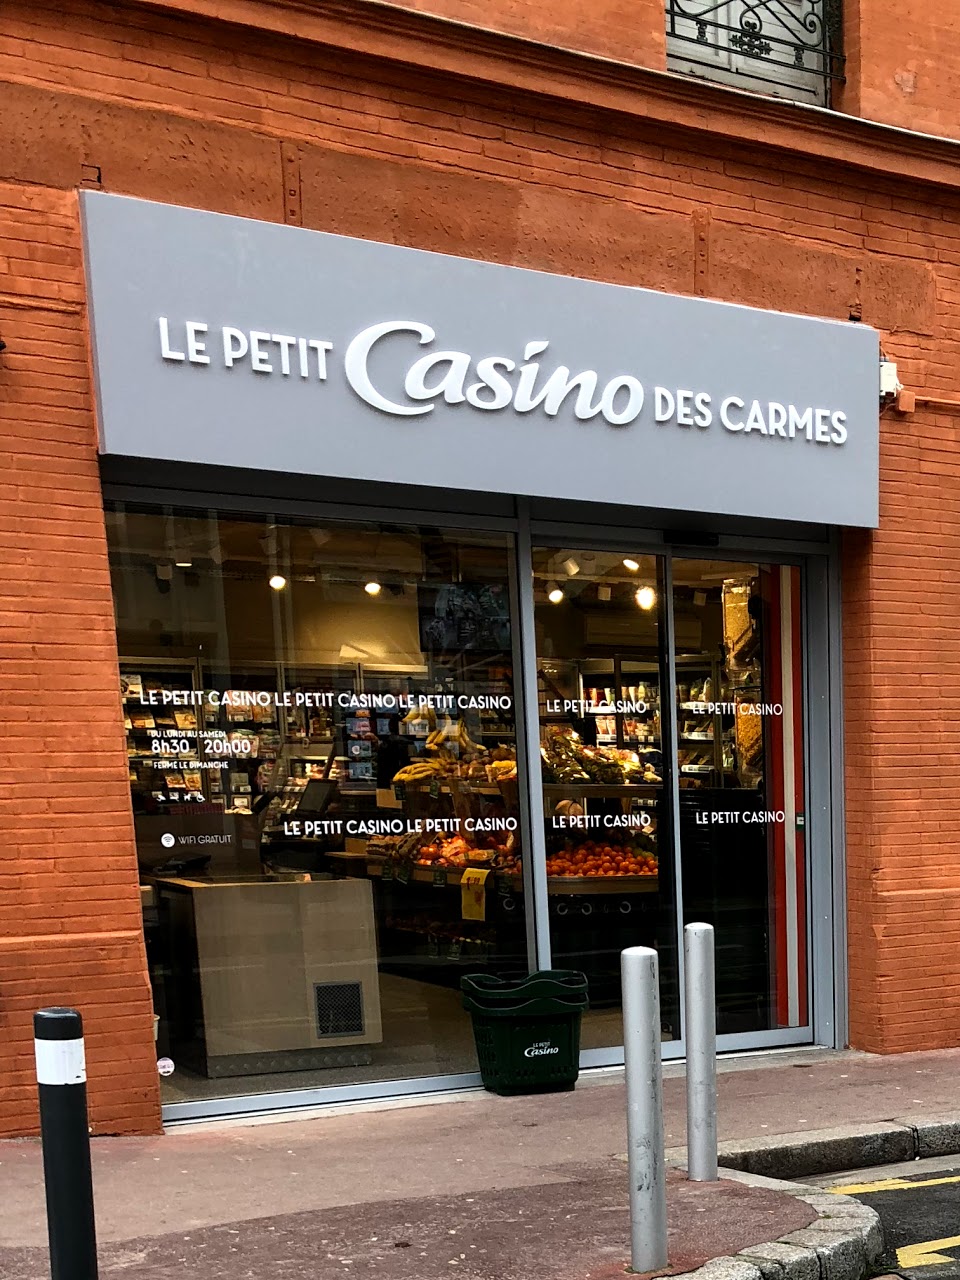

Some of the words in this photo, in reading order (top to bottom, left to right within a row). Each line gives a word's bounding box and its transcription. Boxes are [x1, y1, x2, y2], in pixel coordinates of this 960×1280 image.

[158, 316, 209, 365] LE
[221, 326, 334, 380] PETIT
[344, 320, 641, 425] Casino
[653, 386, 713, 428] DES
[719, 396, 848, 444] CARMES
[140, 690, 158, 705] LE
[163, 690, 204, 706] PETIT
[208, 691, 271, 707] CASINO
[275, 692, 292, 707] LE
[296, 692, 334, 707] PETIT
[338, 693, 396, 708] CASINO
[400, 694, 415, 708] LE
[419, 695, 455, 709] PETIT
[458, 695, 511, 710] CASINO
[546, 699, 561, 713] LE
[564, 699, 594, 713] PETIT
[598, 700, 648, 714] CASINO
[692, 702, 705, 714] LE
[708, 702, 737, 715] PETIT
[740, 703, 783, 716] CASINO
[198, 730, 226, 738] SAMEDI
[151, 739, 189, 754] 8h30
[204, 739, 251, 754] 20h00
[189, 761, 229, 769] DIMANCHE
[552, 815, 566, 828] LE
[569, 815, 601, 828] PETIT
[604, 814, 651, 828] CASINO
[696, 812, 708, 825] LE
[711, 811, 740, 824] PETIT
[743, 810, 785, 823] CASINO
[284, 821, 301, 836] LE
[305, 820, 343, 836] PETIT
[346, 819, 404, 834] CASINO
[407, 819, 422, 833] LE
[426, 818, 461, 832] PETIT
[464, 817, 517, 831] CASINO
[178, 835, 196, 844] WIFI
[198, 834, 232, 844] GRATUIT
[524, 1046, 559, 1058] Casino
